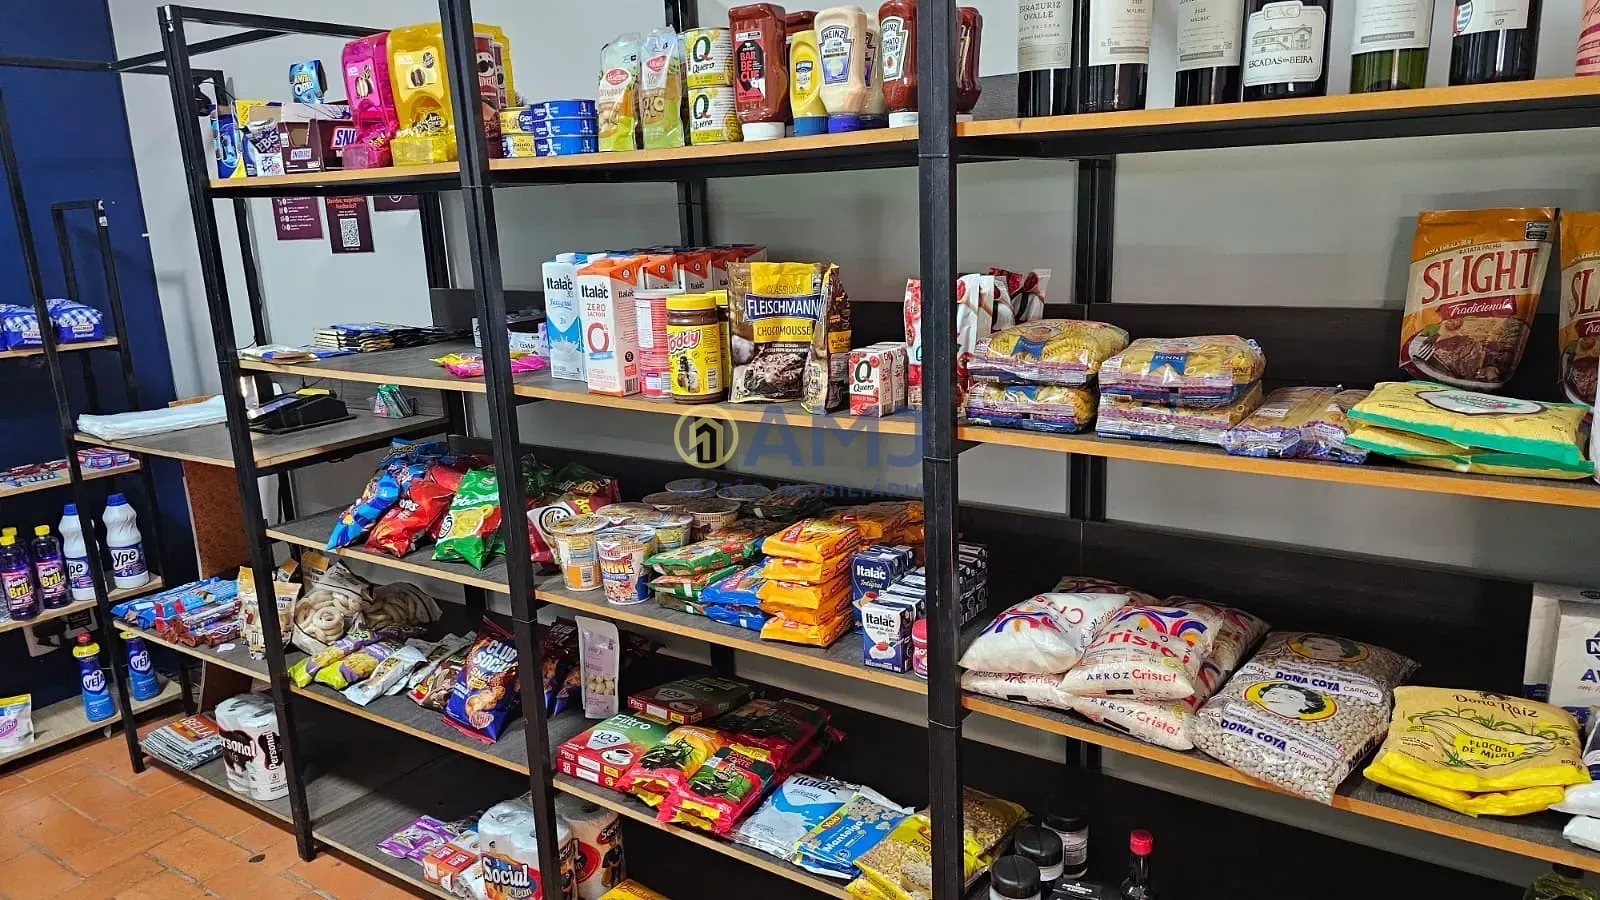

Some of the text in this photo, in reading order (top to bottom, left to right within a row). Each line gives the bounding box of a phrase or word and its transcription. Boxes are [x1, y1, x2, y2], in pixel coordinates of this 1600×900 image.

[1024, 11, 1054, 20] OVALLE
[824, 30, 845, 40] HEINZ
[740, 51, 756, 60] BAR
[1248, 56, 1282, 68] ESCADAS
[1290, 55, 1313, 64] BEIRA
[692, 62, 714, 73] Quero
[741, 61, 752, 71] BE
[294, 82, 314, 96] OREO
[693, 120, 712, 129] Quero
[1421, 248, 1539, 304] SLIGHT
[546, 276, 574, 291] Italac
[581, 284, 608, 299] Italac
[747, 299, 820, 316] FLEISCHMANN
[1449, 300, 1509, 317] Tradicional
[757, 326, 812, 337] CHOCOMOUSSE
[667, 329, 700, 352] Toddy
[853, 384, 874, 392] Quero
[68, 562, 83, 576] pe
[856, 565, 886, 580] Italac
[41, 573, 61, 587] Bril
[9, 584, 29, 598] Bril
[866, 613, 895, 628] Italac
[1086, 671, 1130, 681] ARROZ
[1275, 671, 1308, 684] DONA
[1311, 678, 1340, 692] COTA
[1343, 686, 1380, 700] CARIOCA
[1090, 698, 1134, 718] ARROZ
[1453, 694, 1539, 718] Dona Raiz
[611, 714, 652, 730] Filtro
[594, 732, 620, 743] 103
[1220, 719, 1328, 768] DONA COTA CARIOCA
[220, 736, 256, 757] rsonal
[267, 731, 280, 770] Personal
[1469, 739, 1508, 752] FLOCOS
[793, 777, 840, 795] Italac
[823, 816, 840, 829] Yoki
[824, 821, 864, 852] Manteiga
[911, 839, 930, 852] PIPO
[483, 856, 530, 886] Social
[510, 887, 532, 897] Clean
